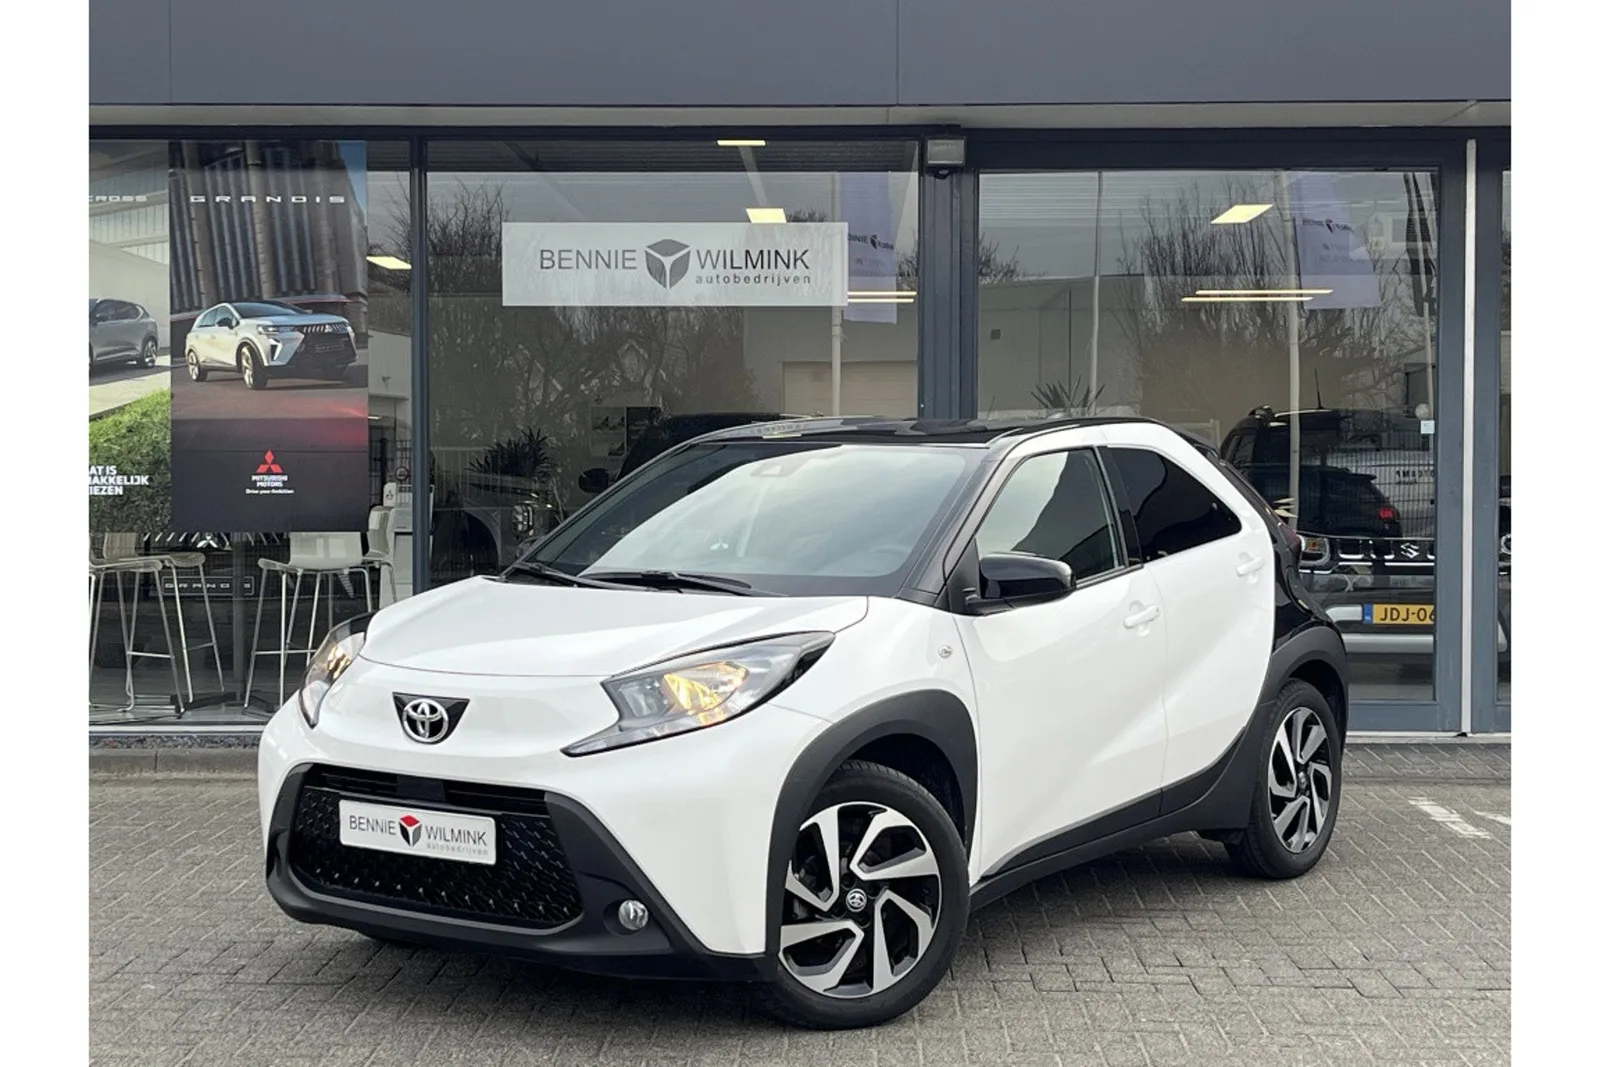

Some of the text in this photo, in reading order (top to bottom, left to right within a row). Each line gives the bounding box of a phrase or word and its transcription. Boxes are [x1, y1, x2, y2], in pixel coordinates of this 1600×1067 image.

[190, 195, 345, 203] GRANDIS
[540, 249, 810, 270] BENNIE WILMINK
[695, 274, 811, 287] autobedrijven
[106, 465, 117, 475] IS
[349, 815, 488, 847] BENNIE WILMINK
